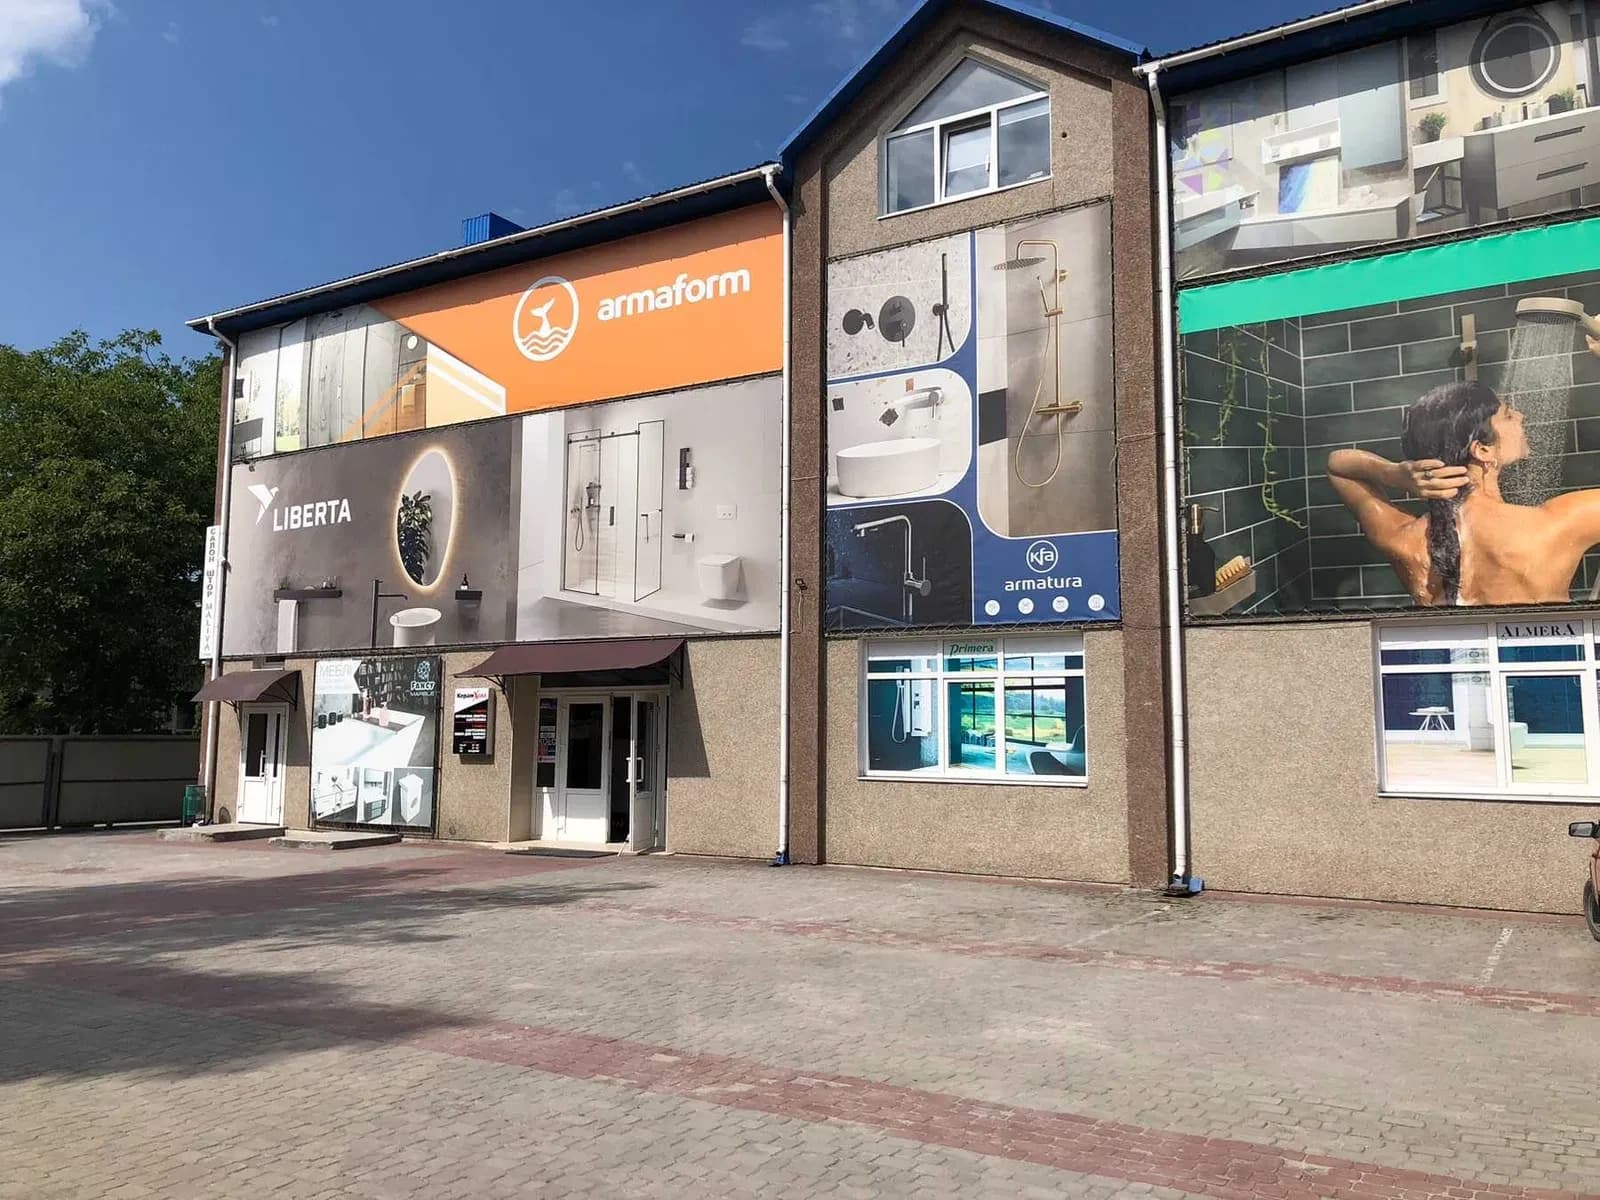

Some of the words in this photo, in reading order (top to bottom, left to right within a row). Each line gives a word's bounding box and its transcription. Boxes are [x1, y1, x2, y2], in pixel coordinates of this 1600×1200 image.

[597, 268, 751, 321] armaform
[273, 498, 352, 532] LIBERTA
[207, 527, 217, 563] САЛОН
[205, 569, 215, 598] ШТОР
[1004, 576, 1083, 592] armatura
[1502, 623, 1576, 638] ALMERA
[949, 643, 994, 657] Primera
[410, 680, 436, 691] FANCY
